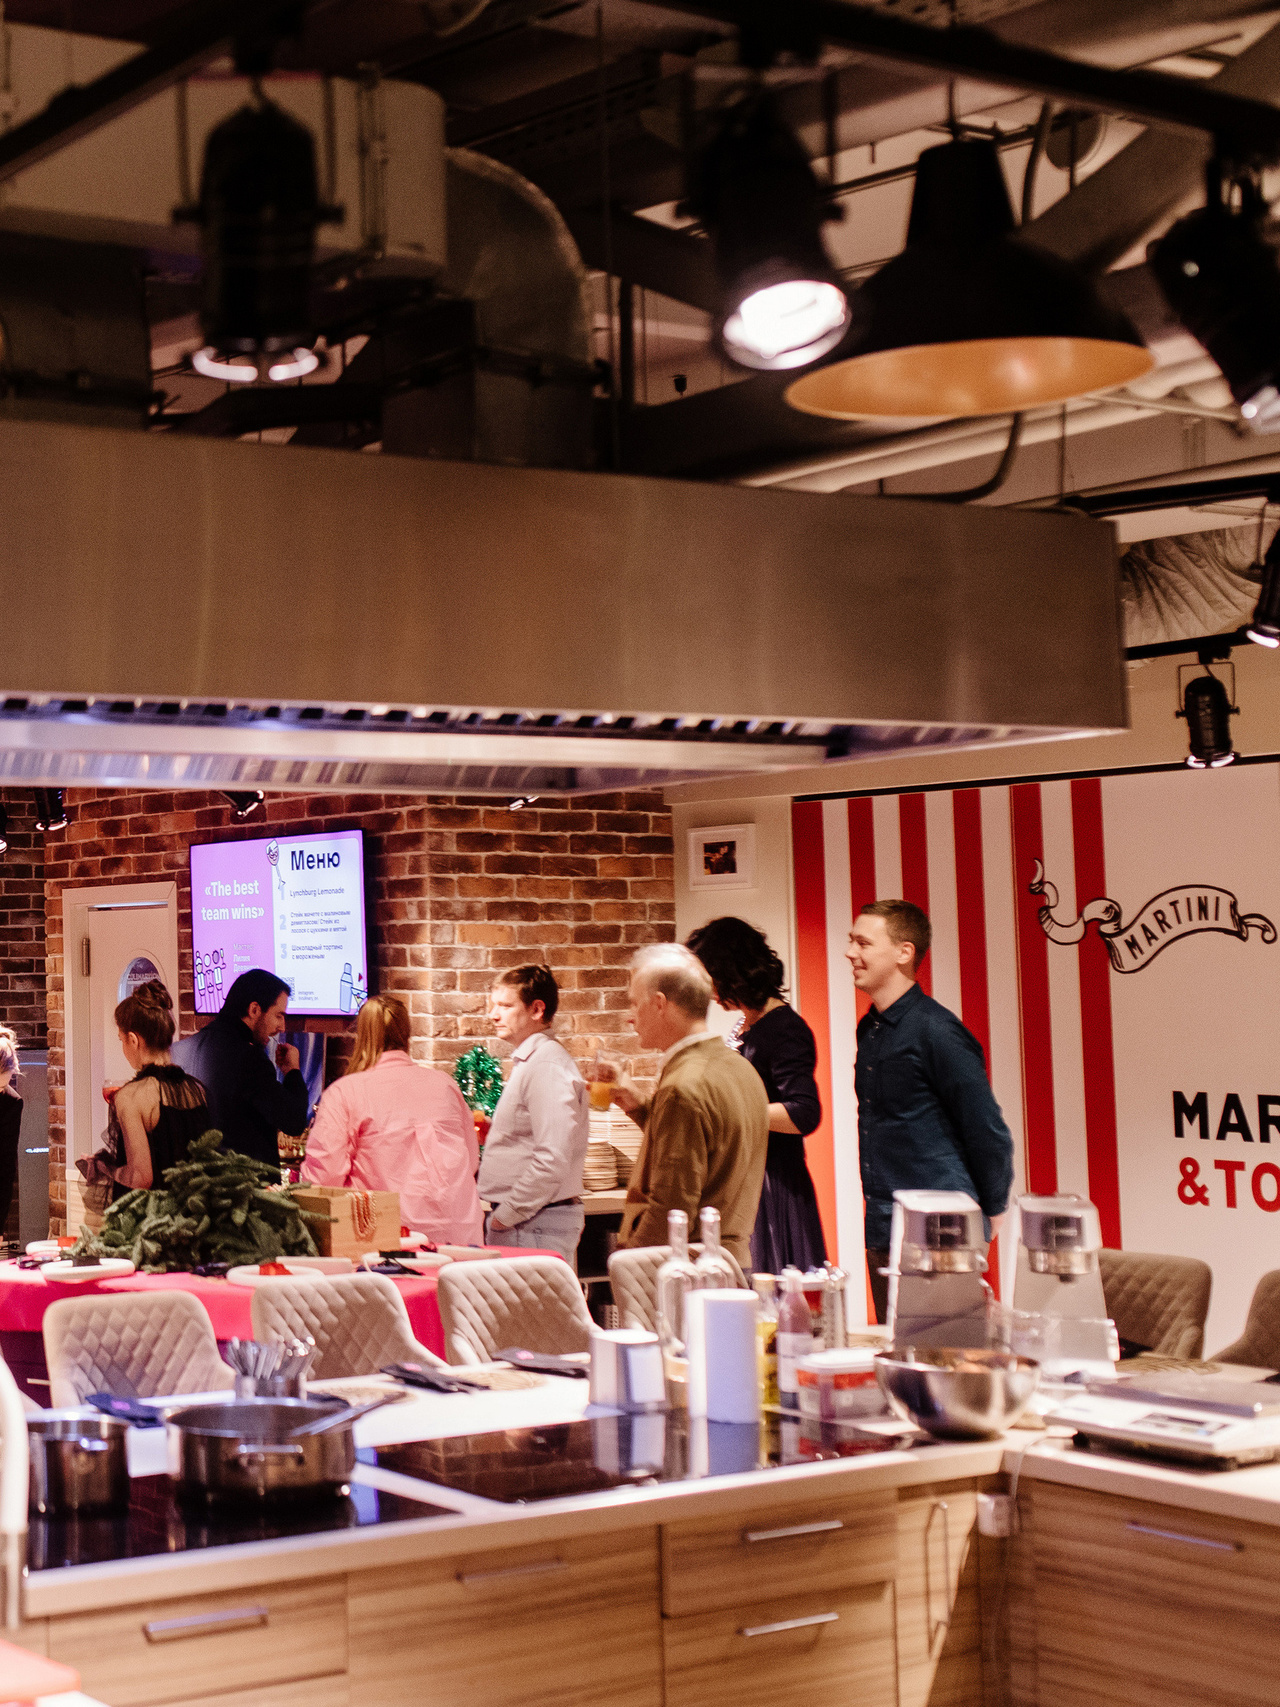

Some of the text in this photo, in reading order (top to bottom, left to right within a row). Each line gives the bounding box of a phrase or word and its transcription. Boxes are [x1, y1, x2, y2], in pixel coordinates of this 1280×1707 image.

[290, 849, 341, 871] Меню
[204, 879, 260, 897] «The best
[317, 887, 345, 896] Lemonade
[201, 903, 265, 921] team wins»
[279, 914, 287, 931] 2
[1123, 895, 1222, 960] MARTINI
[280, 943, 287, 959] 3
[1171, 1089, 1280, 1145] MAR
[1177, 1156, 1280, 1213] &TO
